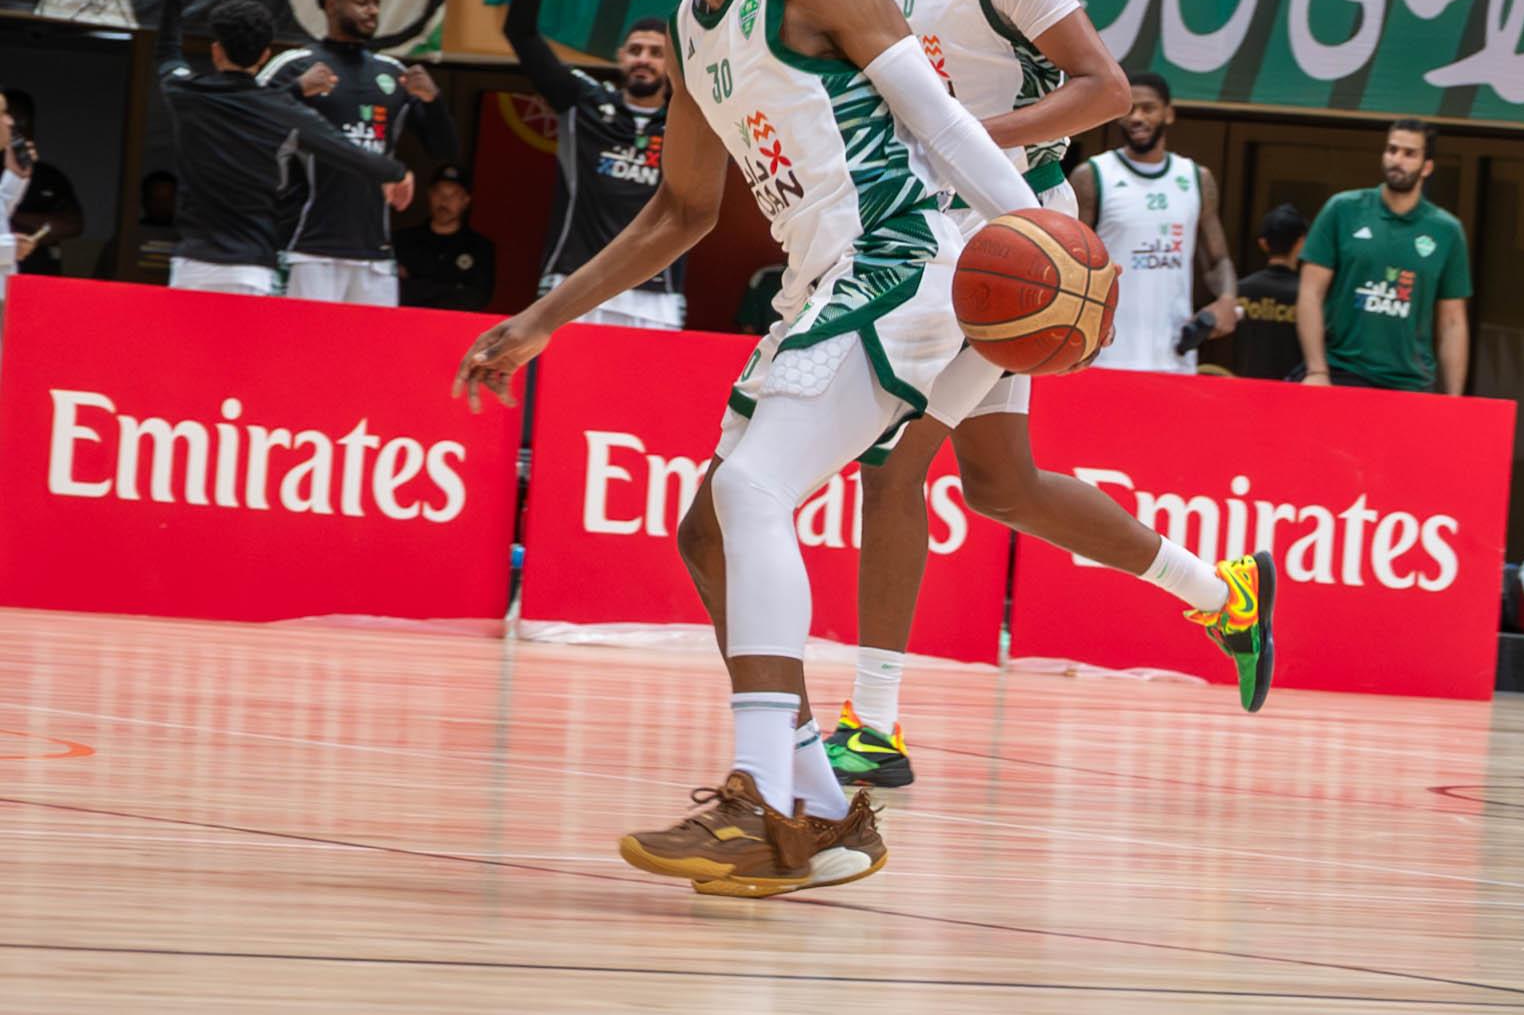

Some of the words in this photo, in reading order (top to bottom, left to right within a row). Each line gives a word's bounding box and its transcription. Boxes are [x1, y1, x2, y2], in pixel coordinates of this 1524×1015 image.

[705, 57, 734, 105] 30
[1146, 193, 1168, 210] 28
[1364, 295, 1412, 318] DAN
[48, 388, 467, 523] Emirates
